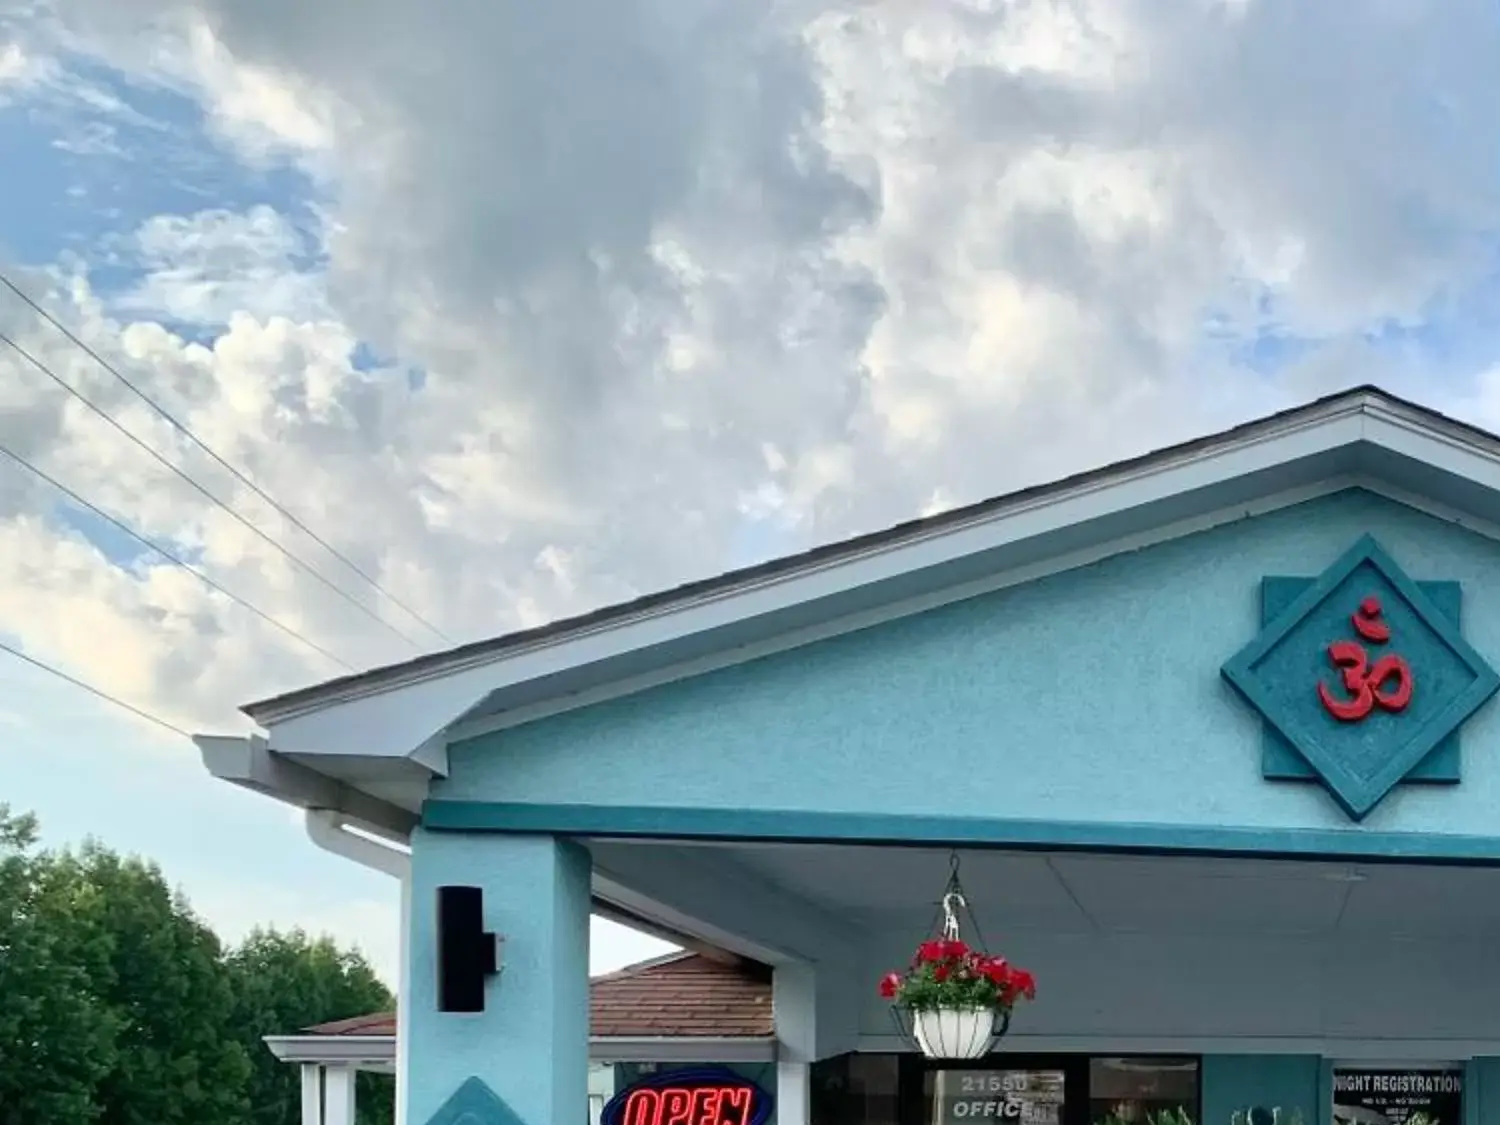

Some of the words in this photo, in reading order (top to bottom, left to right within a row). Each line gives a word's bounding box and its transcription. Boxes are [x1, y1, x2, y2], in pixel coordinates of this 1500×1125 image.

[1334, 1075, 1371, 1092] NIGHT
[1373, 1075, 1462, 1092] REGISTRATION
[953, 1101, 1034, 1118] OFFICE
